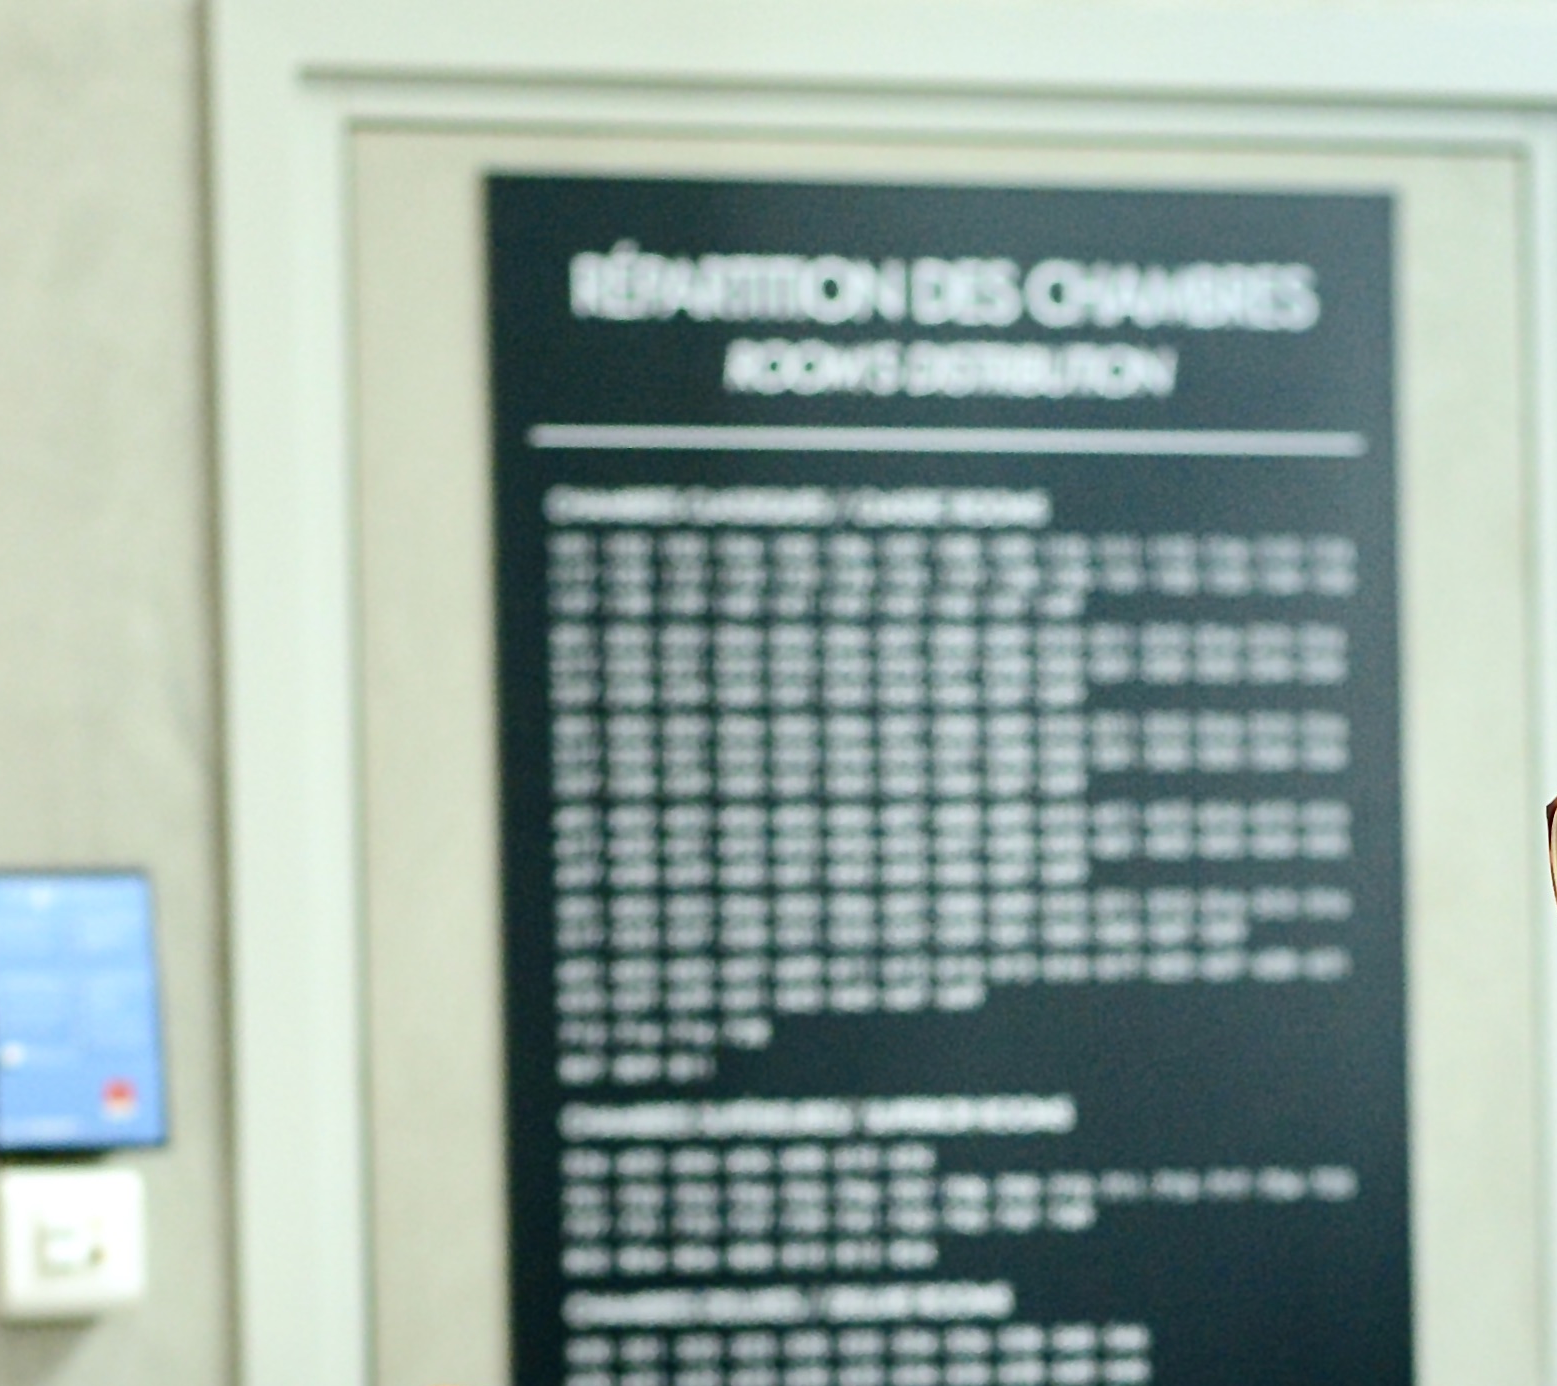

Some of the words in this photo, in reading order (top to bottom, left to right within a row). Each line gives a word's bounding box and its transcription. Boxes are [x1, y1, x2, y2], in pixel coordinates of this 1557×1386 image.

[569, 238, 907, 321] RÉPARTITION
[910, 256, 1023, 327] DES
[1023, 258, 1321, 333] CHAMBRES
